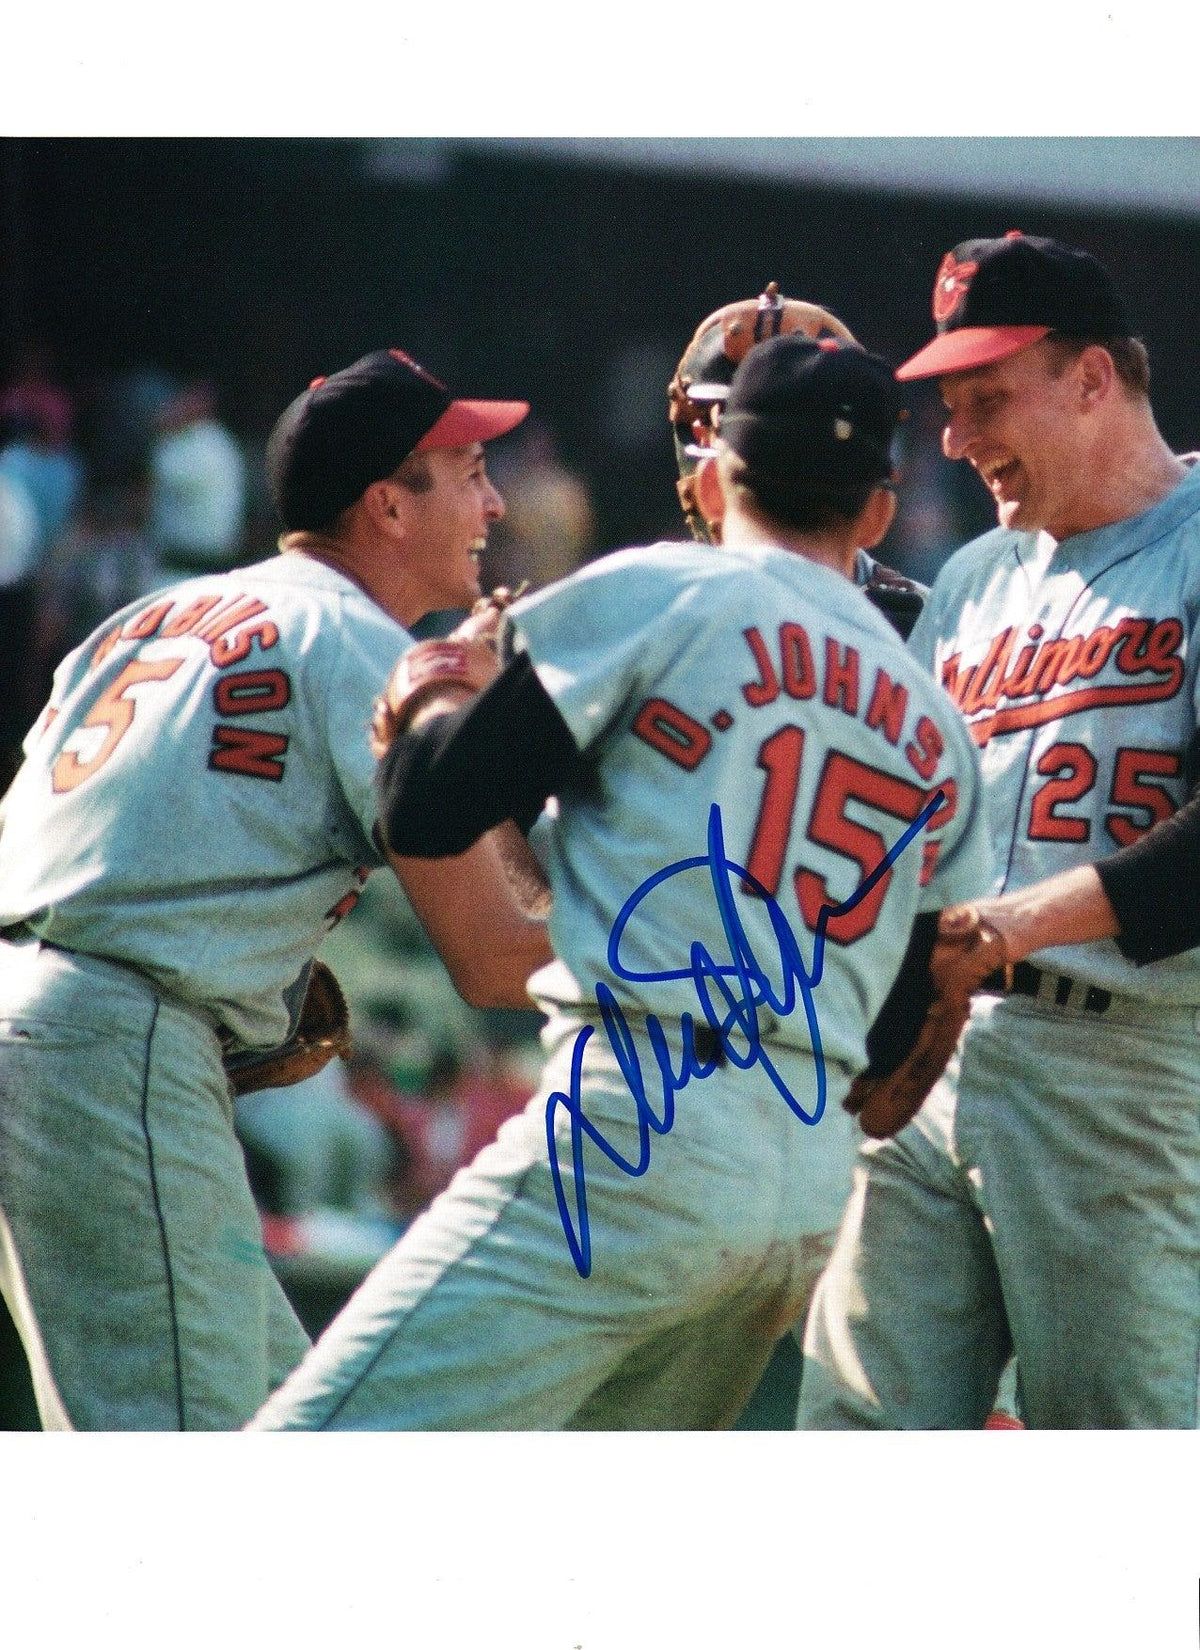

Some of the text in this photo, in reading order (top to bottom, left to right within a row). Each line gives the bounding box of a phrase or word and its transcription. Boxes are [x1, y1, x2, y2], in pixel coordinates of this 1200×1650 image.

[51, 656, 187, 795] 5
[739, 723, 928, 947] 15
[1027, 742, 1181, 849] 25
